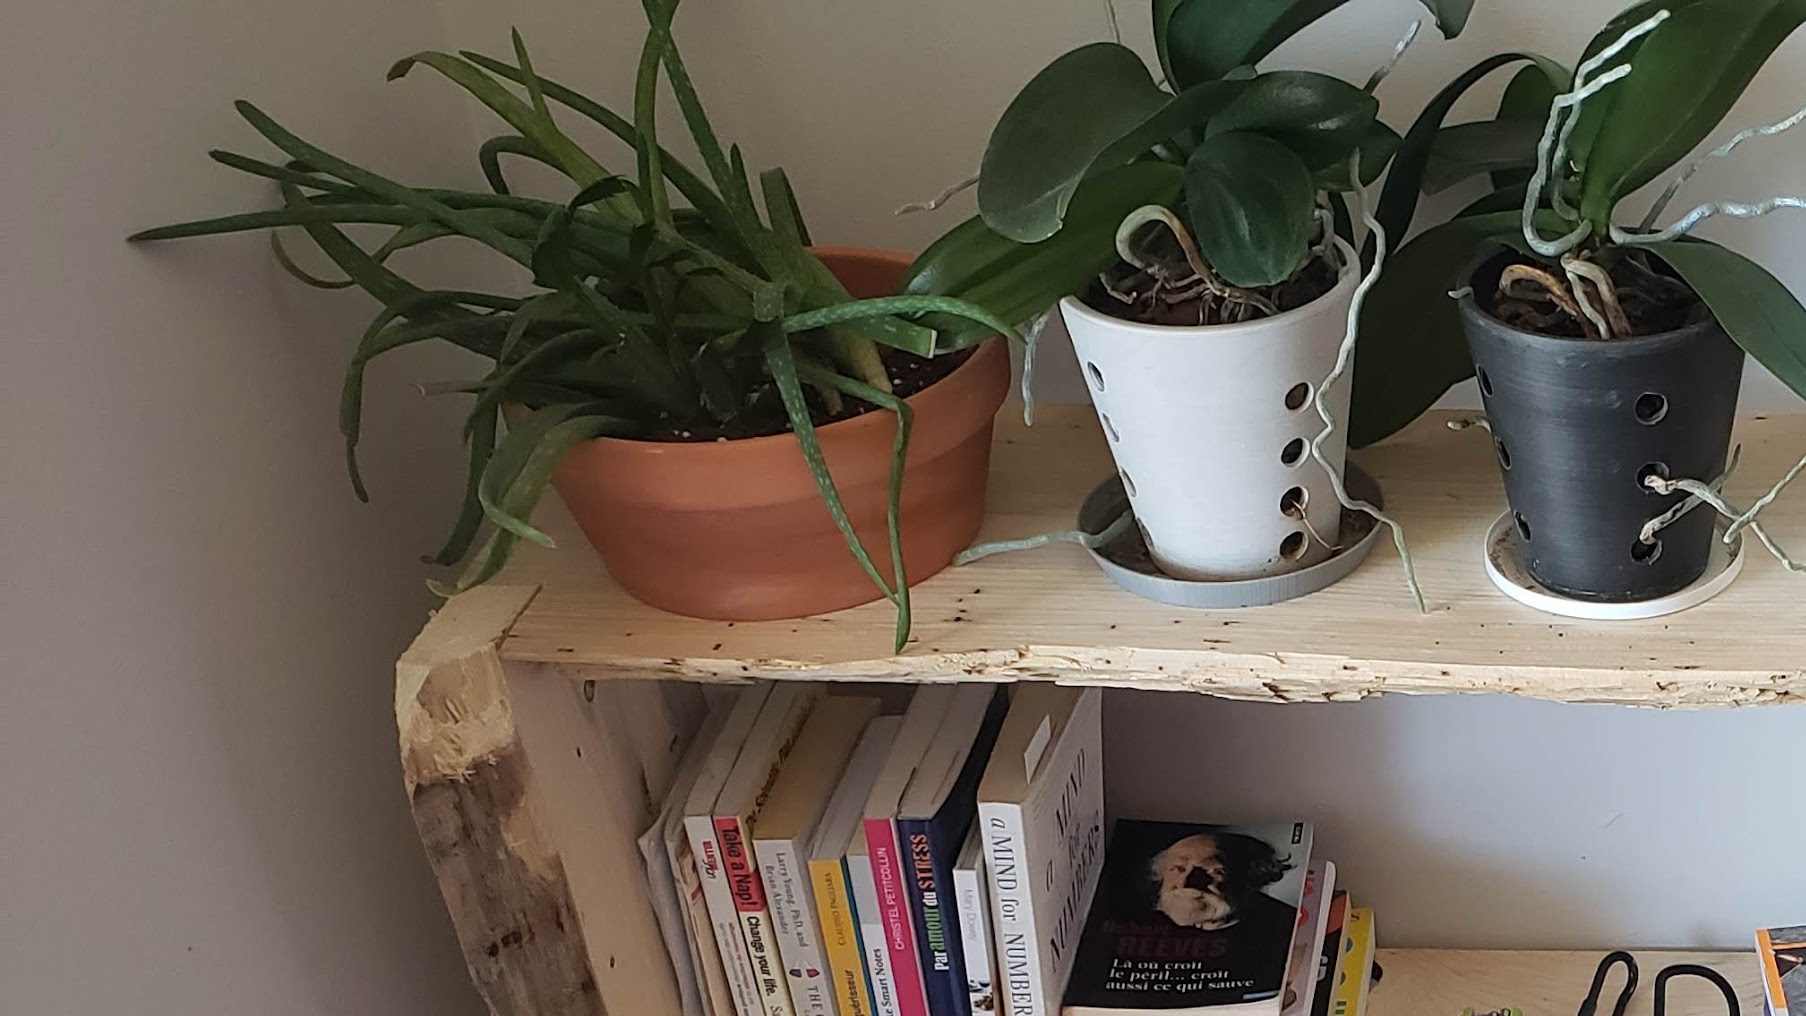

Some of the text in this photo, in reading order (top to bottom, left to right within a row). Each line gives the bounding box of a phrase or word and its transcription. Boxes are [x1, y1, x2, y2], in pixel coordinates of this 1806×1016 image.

[990, 817, 1006, 829] a
[721, 826, 742, 858] Take
[731, 863, 743, 872] a
[991, 835, 1018, 891] MIND
[735, 874, 759, 909] Nap!
[763, 864, 791, 936] Brian Alexander
[874, 845, 907, 951] CHRISTEL PETITCOLLIN
[909, 832, 950, 972] Par amour du STRESS
[1002, 898, 1020, 921] for
[746, 915, 778, 997] Change your life.
[870, 947, 886, 977] Notes
[1113, 958, 1132, 969] Là
[1105, 978, 1255, 993] aussi ce qui sauve
[1109, 968, 1125, 979] le
[806, 984, 823, 1010] THE
[876, 977, 892, 1007] Smart
